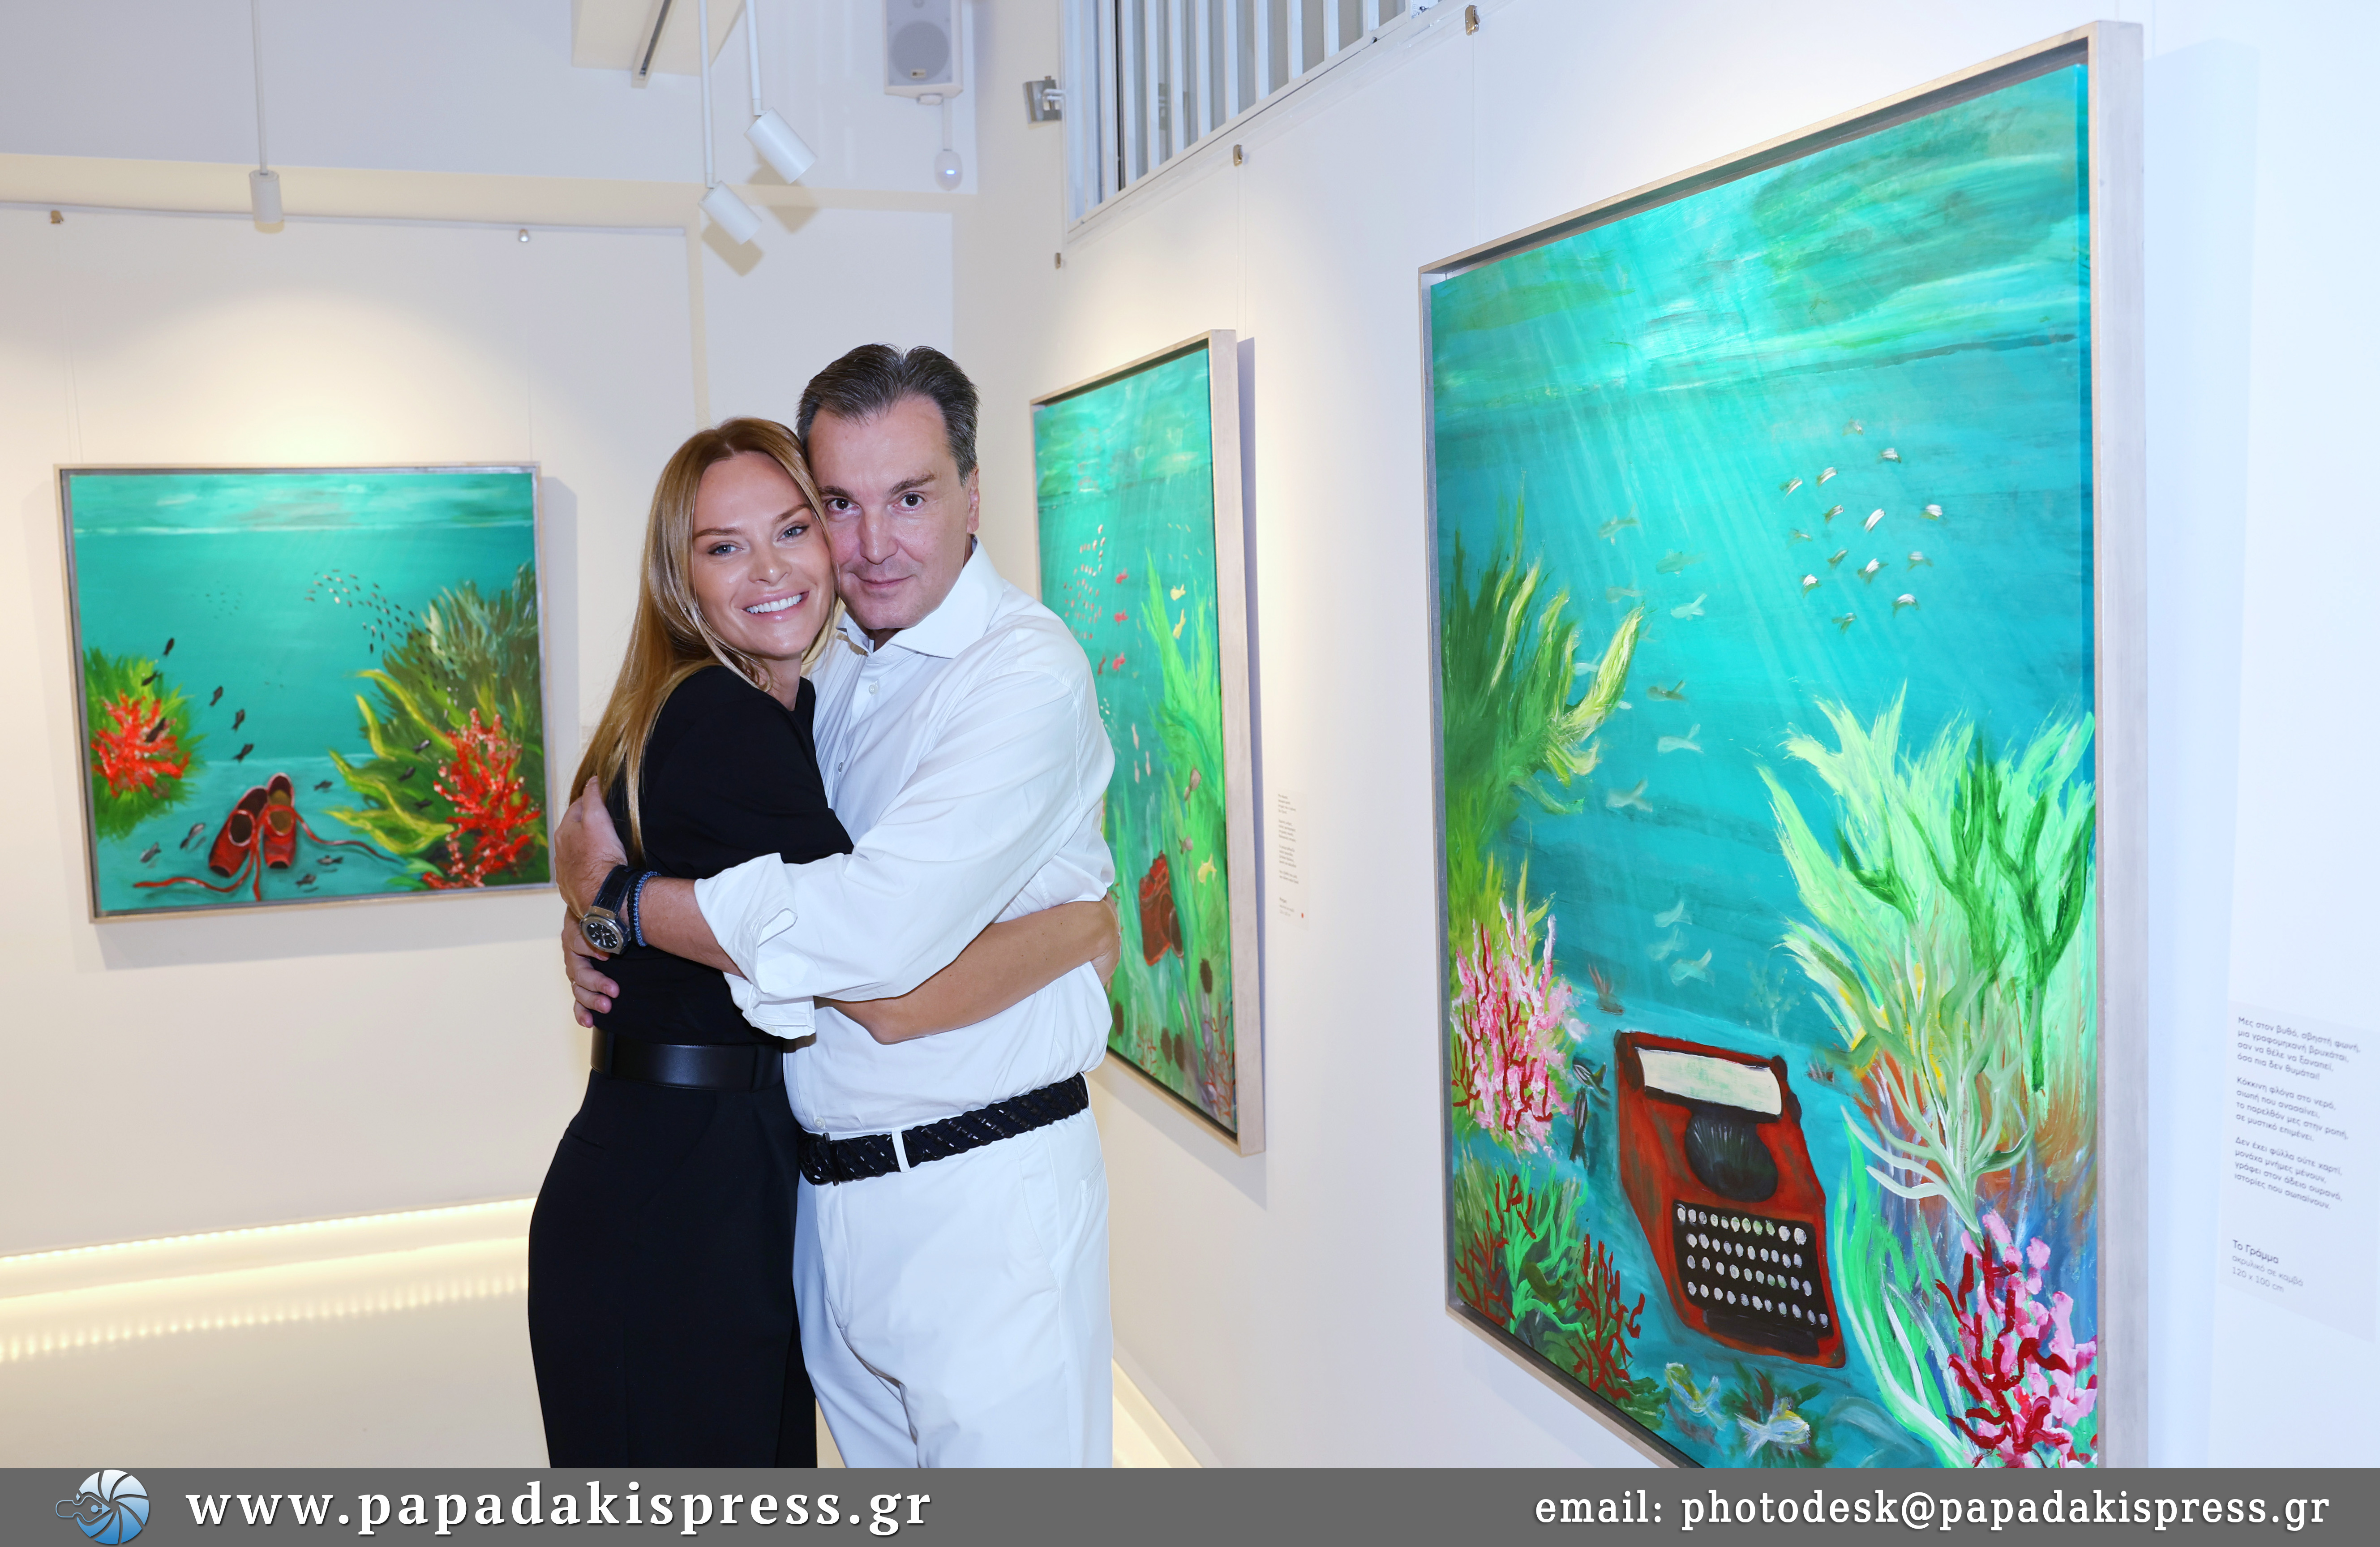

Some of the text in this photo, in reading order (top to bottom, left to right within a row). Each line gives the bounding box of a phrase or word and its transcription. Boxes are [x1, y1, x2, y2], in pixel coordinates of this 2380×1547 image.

[2237, 1042, 2252, 1050] σαν
[2238, 1016, 2361, 1054] Μες στον βυθό, σβηστή φωνή,
[2252, 1034, 2307, 1053] γραφομηχανή
[2237, 1053, 2252, 1063] όσα
[2254, 1058, 2267, 1066] πια
[2269, 1060, 2283, 1070] δεν
[2236, 1090, 2260, 1102] σιωπή
[2261, 1097, 2276, 1105] που
[2237, 1076, 2336, 1111] Κόκκινη φλόγα στο νερό,
[2247, 1105, 2285, 1120] παρελθόν
[2287, 1117, 2300, 1126] μες
[2303, 1121, 2323, 1131] στην
[2247, 1117, 2277, 1130] μυστικό
[2235, 1136, 2250, 1147] Δεν
[2252, 1142, 2267, 1152] έχει
[2269, 1148, 2294, 1160] φύλλα
[2297, 1156, 2316, 1167] ούτε
[2235, 1150, 2263, 1163] μονάχα
[2265, 1160, 2293, 1173] μνήμες
[2234, 1161, 2261, 1174] γράφει
[2264, 1171, 2282, 1181] στον
[2284, 1177, 2307, 1189] άδειο
[2234, 1173, 2265, 1189] ιστορίες
[2268, 1184, 2283, 1194] που
[2232, 1239, 2279, 1264] Το Γράμμα
[2232, 1255, 2303, 1287] ακρυλικό σε καμβά
[2233, 1267, 2247, 1278] 120
[2256, 1276, 2270, 1287] 100
[2272, 1284, 2284, 1292] cm
